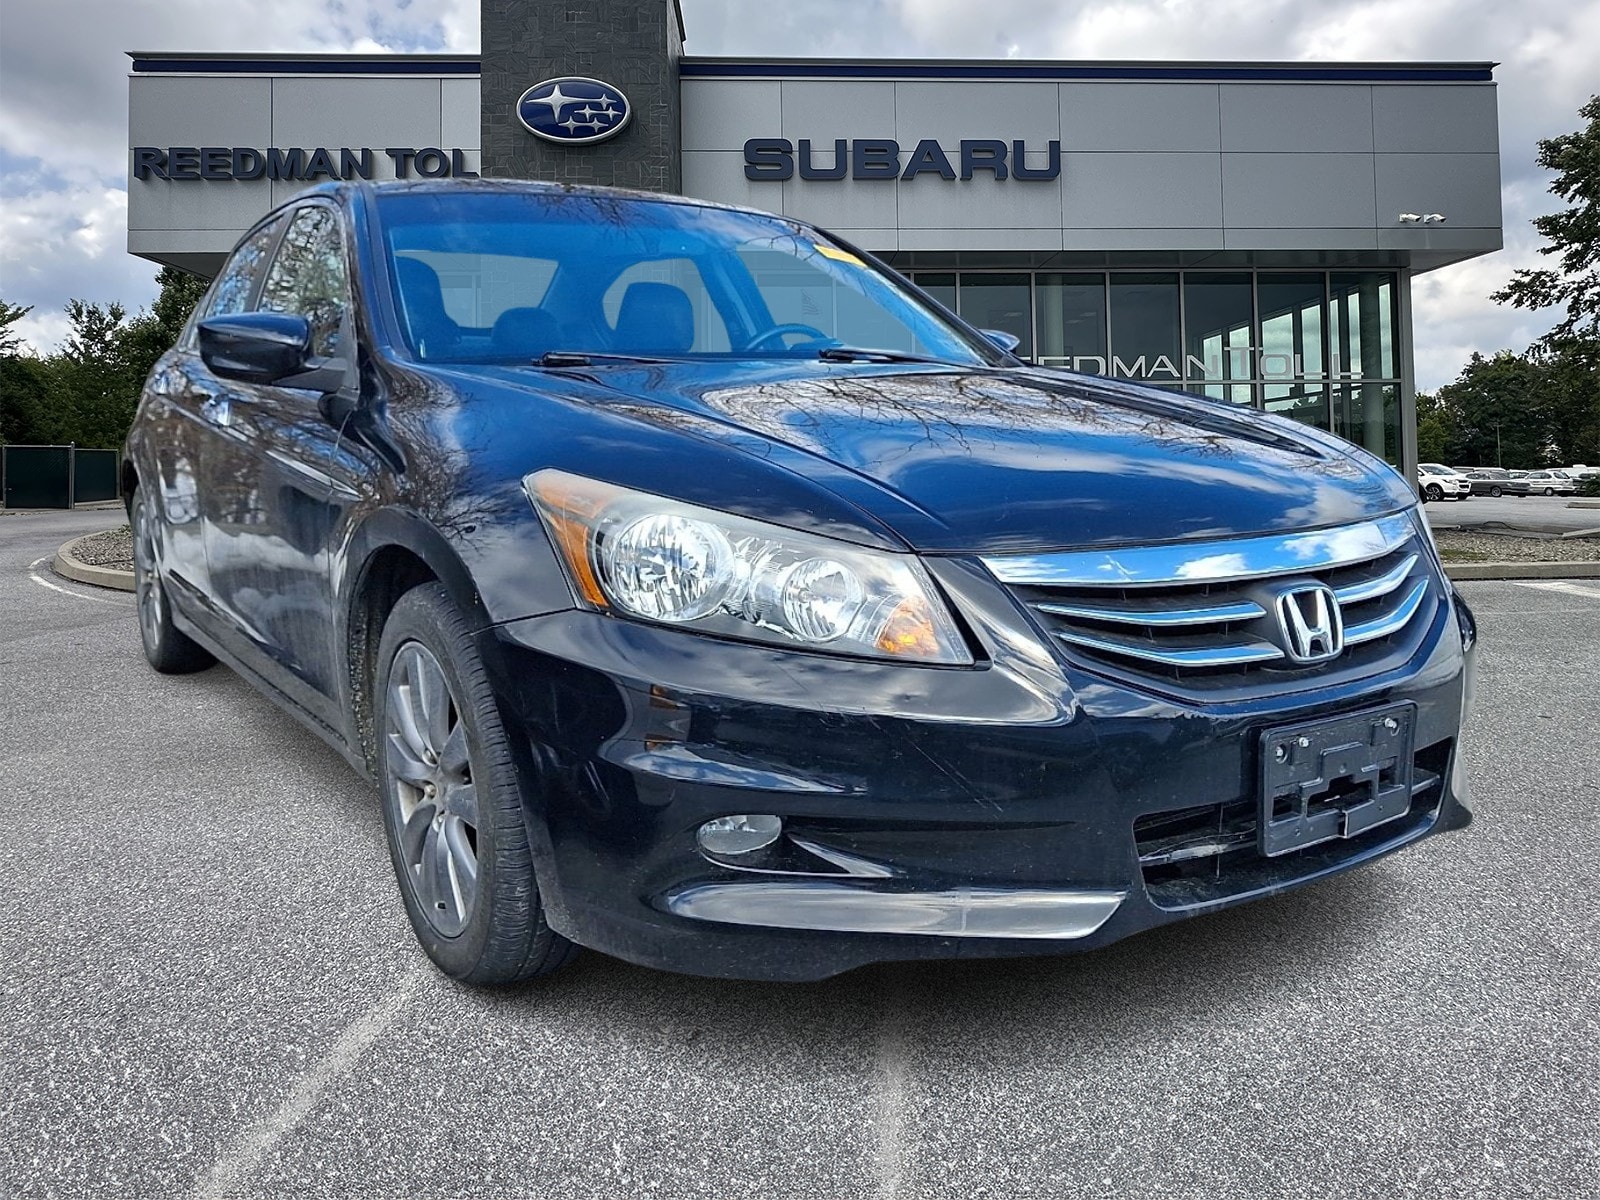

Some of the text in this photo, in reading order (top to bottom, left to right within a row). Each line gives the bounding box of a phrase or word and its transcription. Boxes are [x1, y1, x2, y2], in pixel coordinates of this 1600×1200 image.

[133, 147, 481, 181] REEDMAN TOL
[743, 138, 1061, 181] SUBARU
